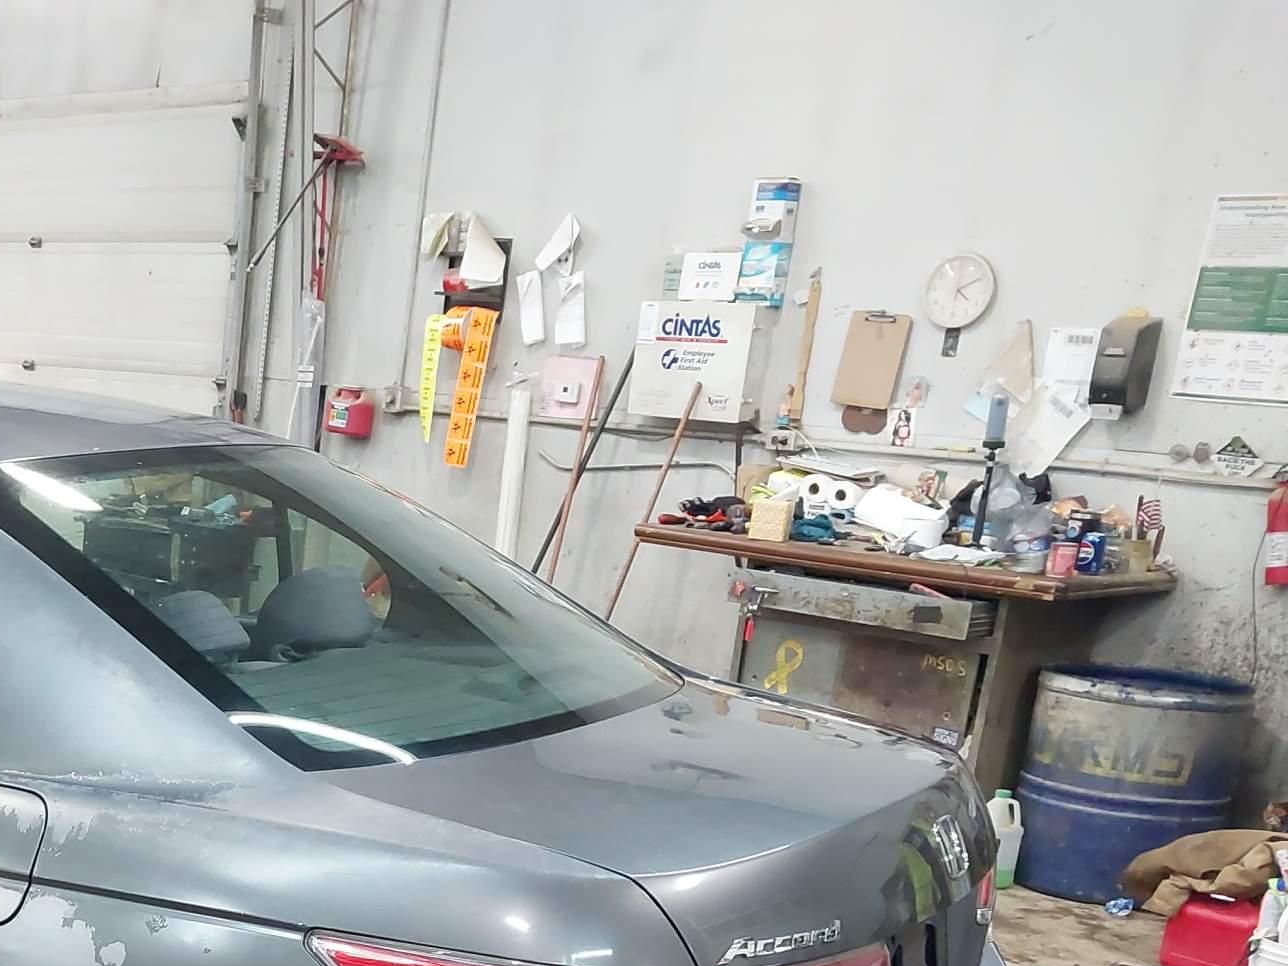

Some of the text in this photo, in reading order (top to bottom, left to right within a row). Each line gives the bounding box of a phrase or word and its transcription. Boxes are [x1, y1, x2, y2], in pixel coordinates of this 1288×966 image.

[661, 312, 721, 338] CINTAS
[682, 349, 716, 358] Employee
[716, 919, 841, 966] Accord
